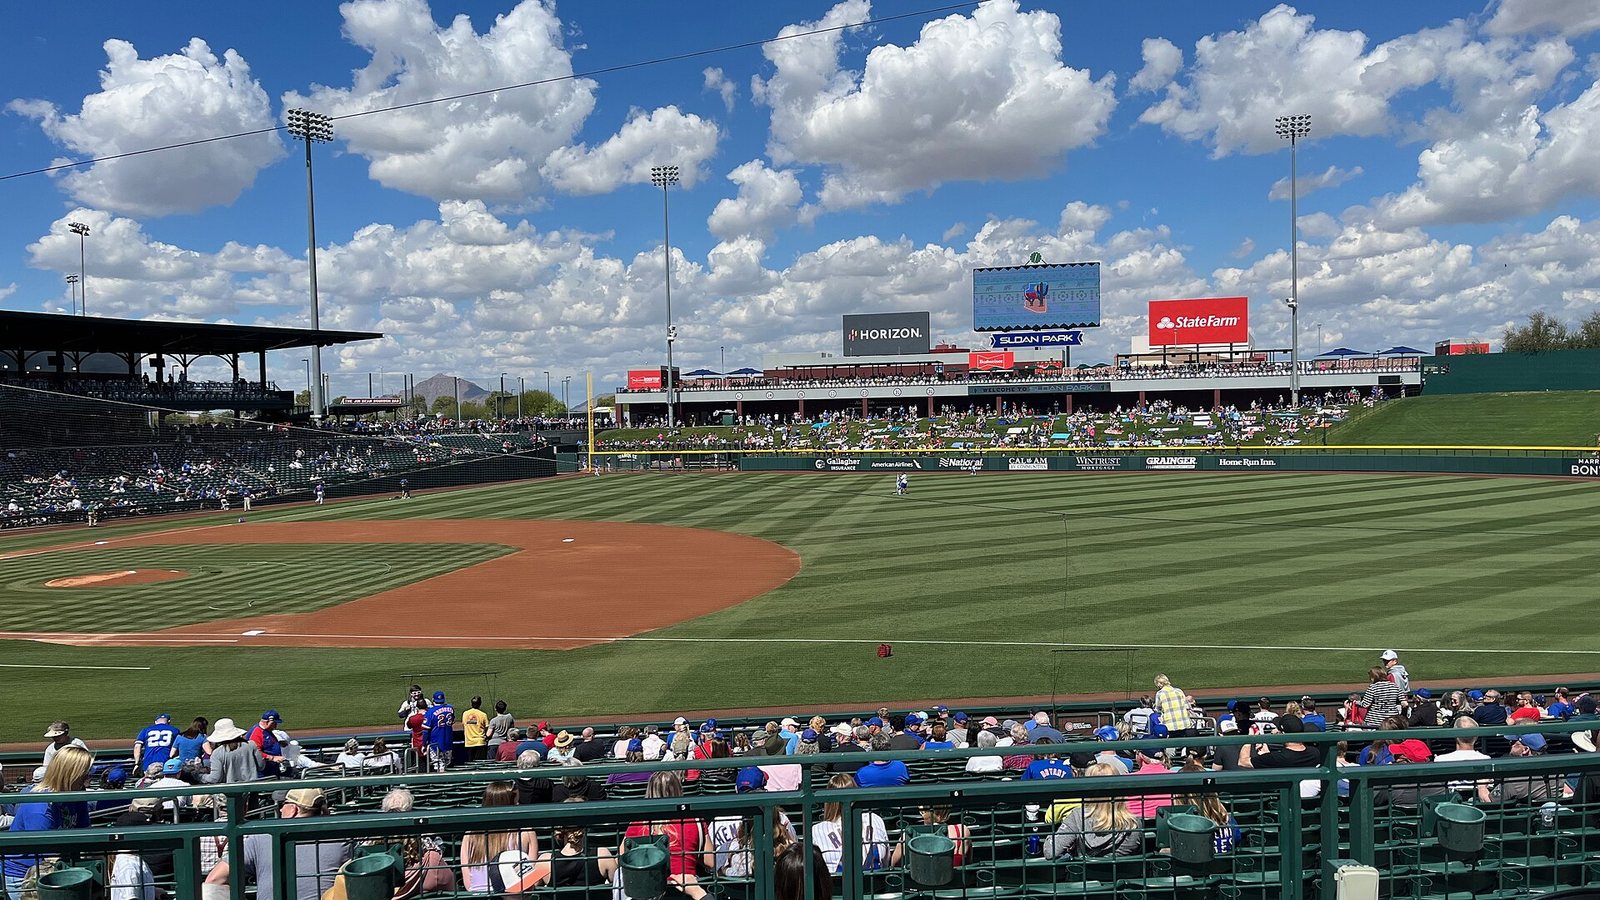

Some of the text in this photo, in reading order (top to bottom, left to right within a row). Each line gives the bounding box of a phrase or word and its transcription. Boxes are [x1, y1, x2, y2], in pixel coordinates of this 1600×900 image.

[1000, 334, 1073, 344] SLOAN PARK
[826, 458, 860, 466] Gallagher
[1076, 457, 1120, 465] WINTRUST
[1243, 459, 1260, 467] Run
[437, 713, 452, 728] 23
[148, 730, 173, 747] 23
[1040, 768, 1066, 778] BRYANT
